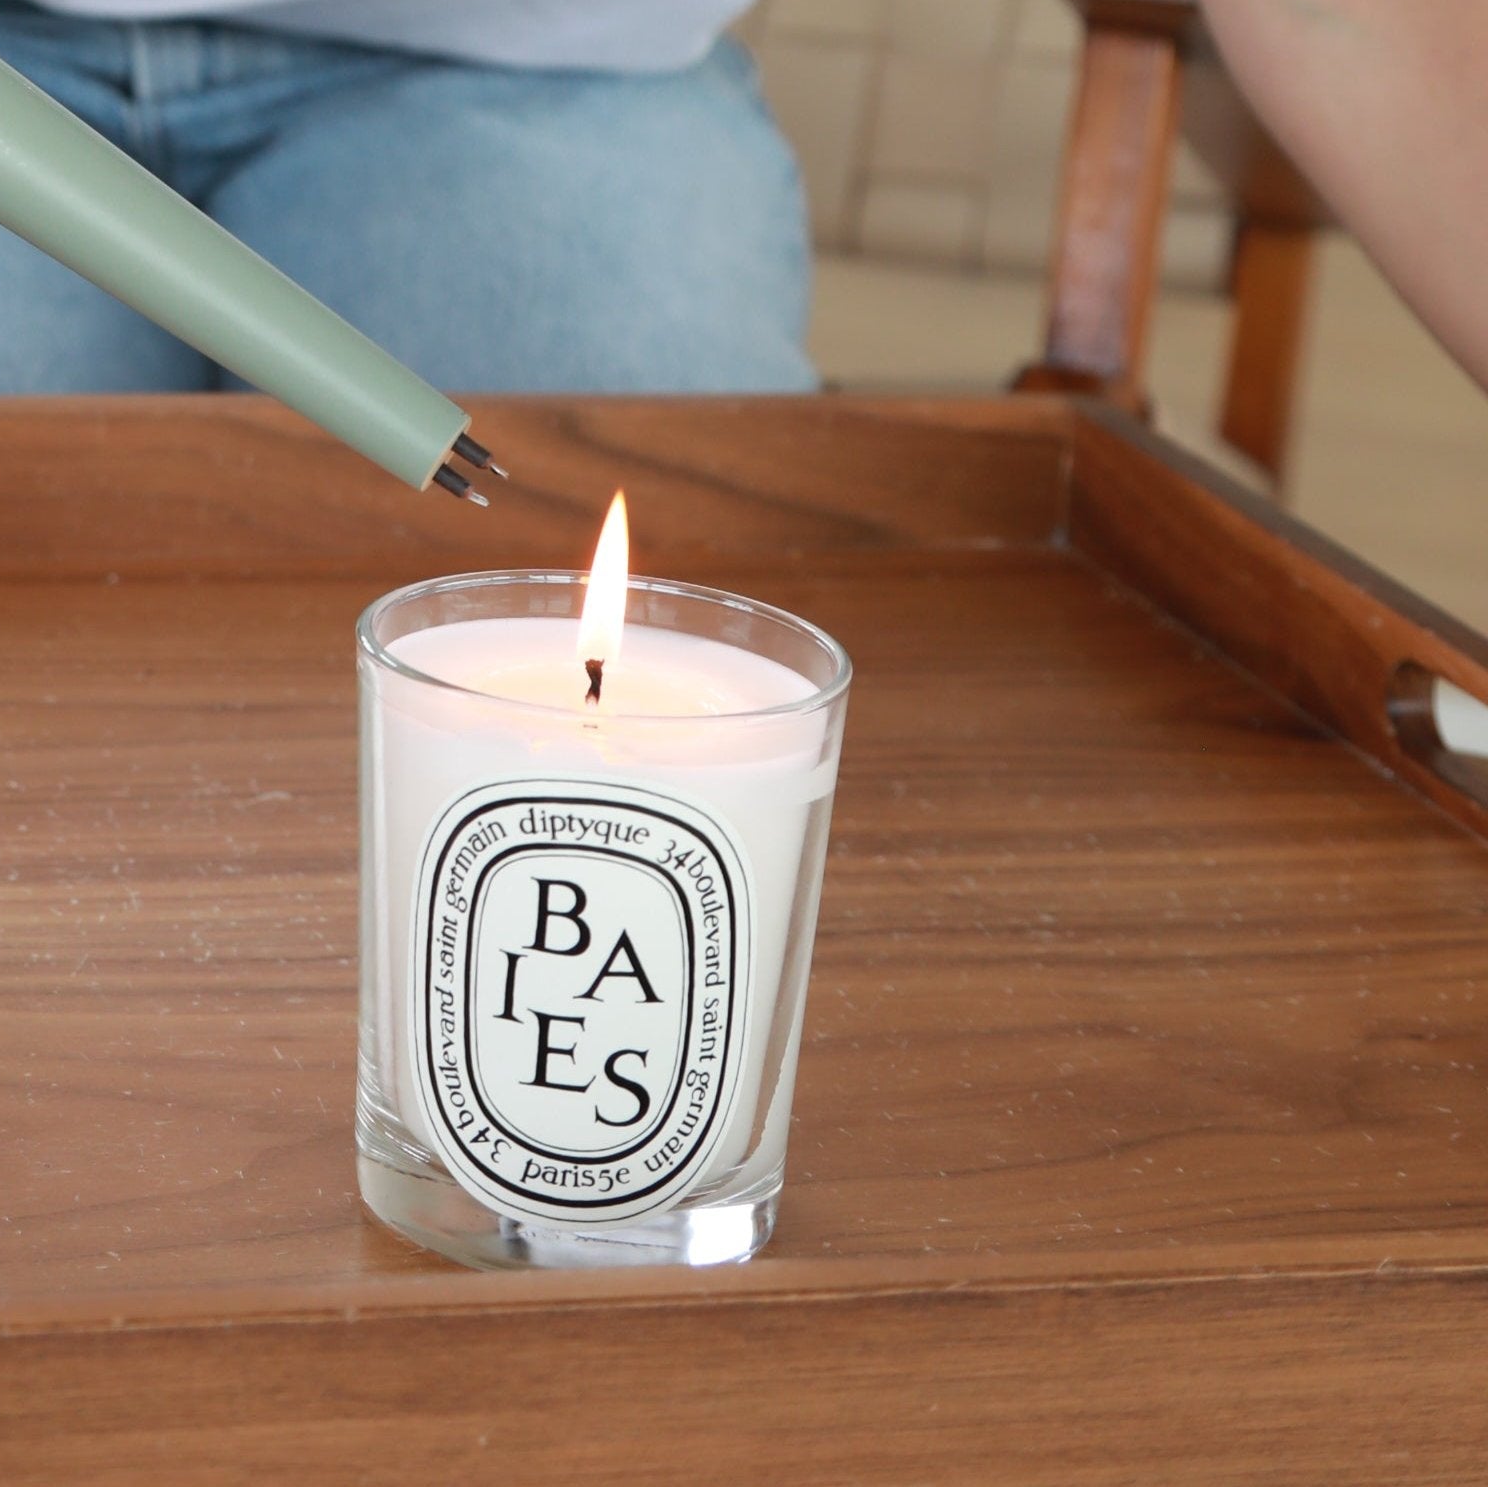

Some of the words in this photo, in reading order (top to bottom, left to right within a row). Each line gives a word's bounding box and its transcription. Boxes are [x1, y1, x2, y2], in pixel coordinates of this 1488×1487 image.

[518, 807, 651, 847] diptyque
[445, 820, 508, 914] germain
[436, 914, 459, 984] saint
[699, 998, 724, 1063] saint
[643, 1068, 711, 1174] germain
